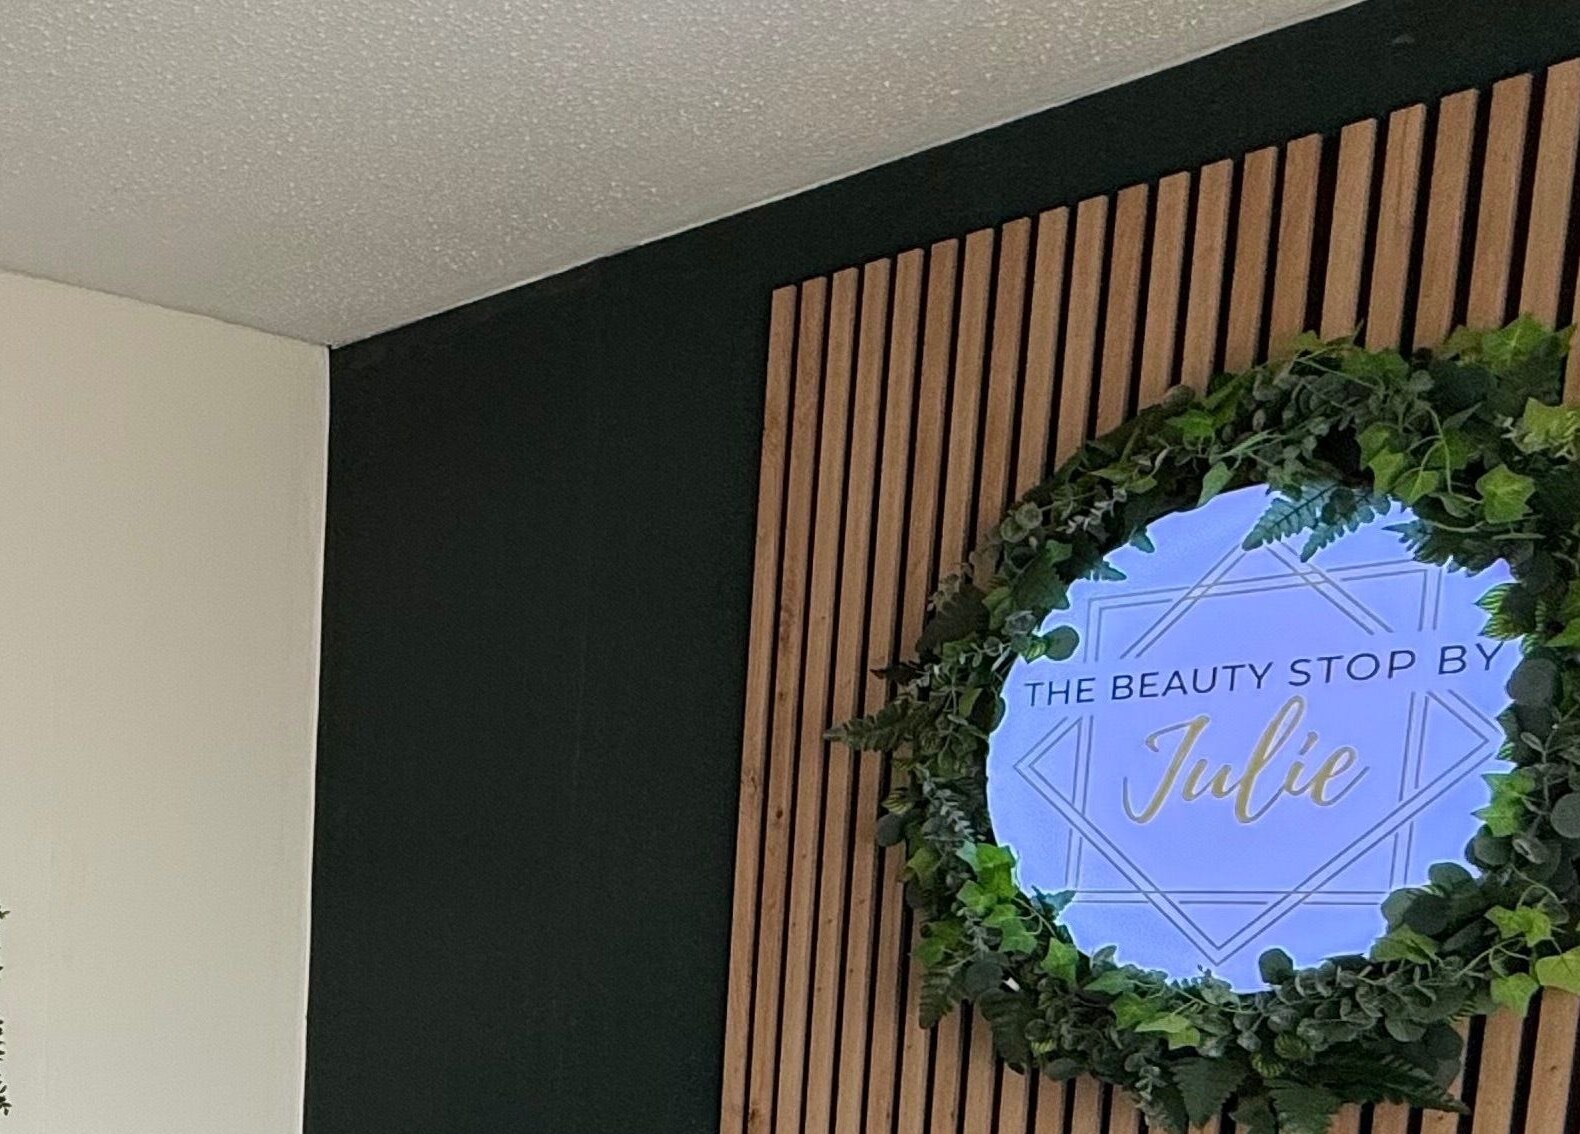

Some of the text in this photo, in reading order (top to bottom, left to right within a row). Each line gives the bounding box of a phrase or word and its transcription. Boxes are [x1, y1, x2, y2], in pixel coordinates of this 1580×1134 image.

[1023, 641, 1505, 707] THE BEAUTY STOP BY
[1122, 694, 1370, 824] Julie
